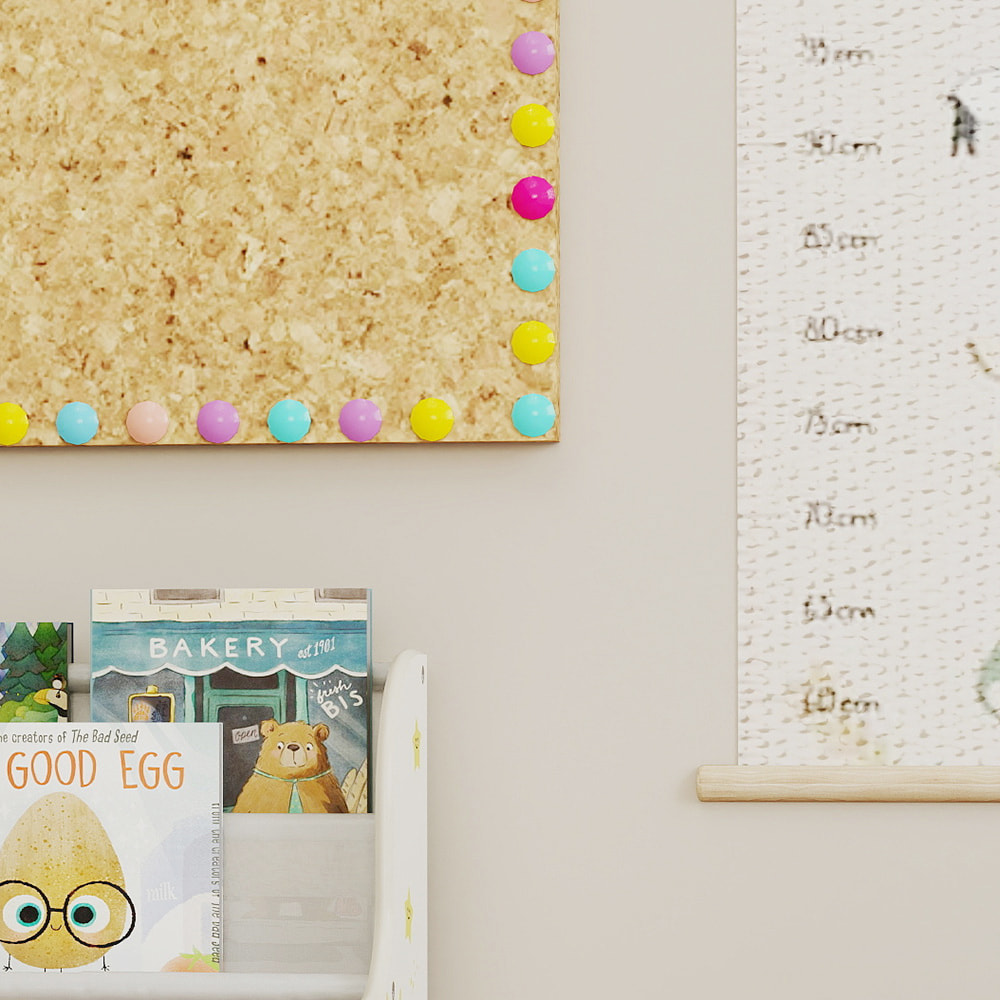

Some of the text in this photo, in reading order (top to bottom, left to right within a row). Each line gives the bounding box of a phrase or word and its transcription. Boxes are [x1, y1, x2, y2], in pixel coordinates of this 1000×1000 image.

[149, 636, 289, 659] BAKERY
[313, 636, 336, 657] 1901
[11, 731, 54, 744] creators
[57, 730, 68, 744] of
[71, 729, 89, 744] The
[91, 729, 112, 743] Bad
[113, 729, 140, 744] Seed
[6, 749, 97, 790] GOOD
[119, 749, 186, 790] EGG
[145, 881, 177, 901] milk
